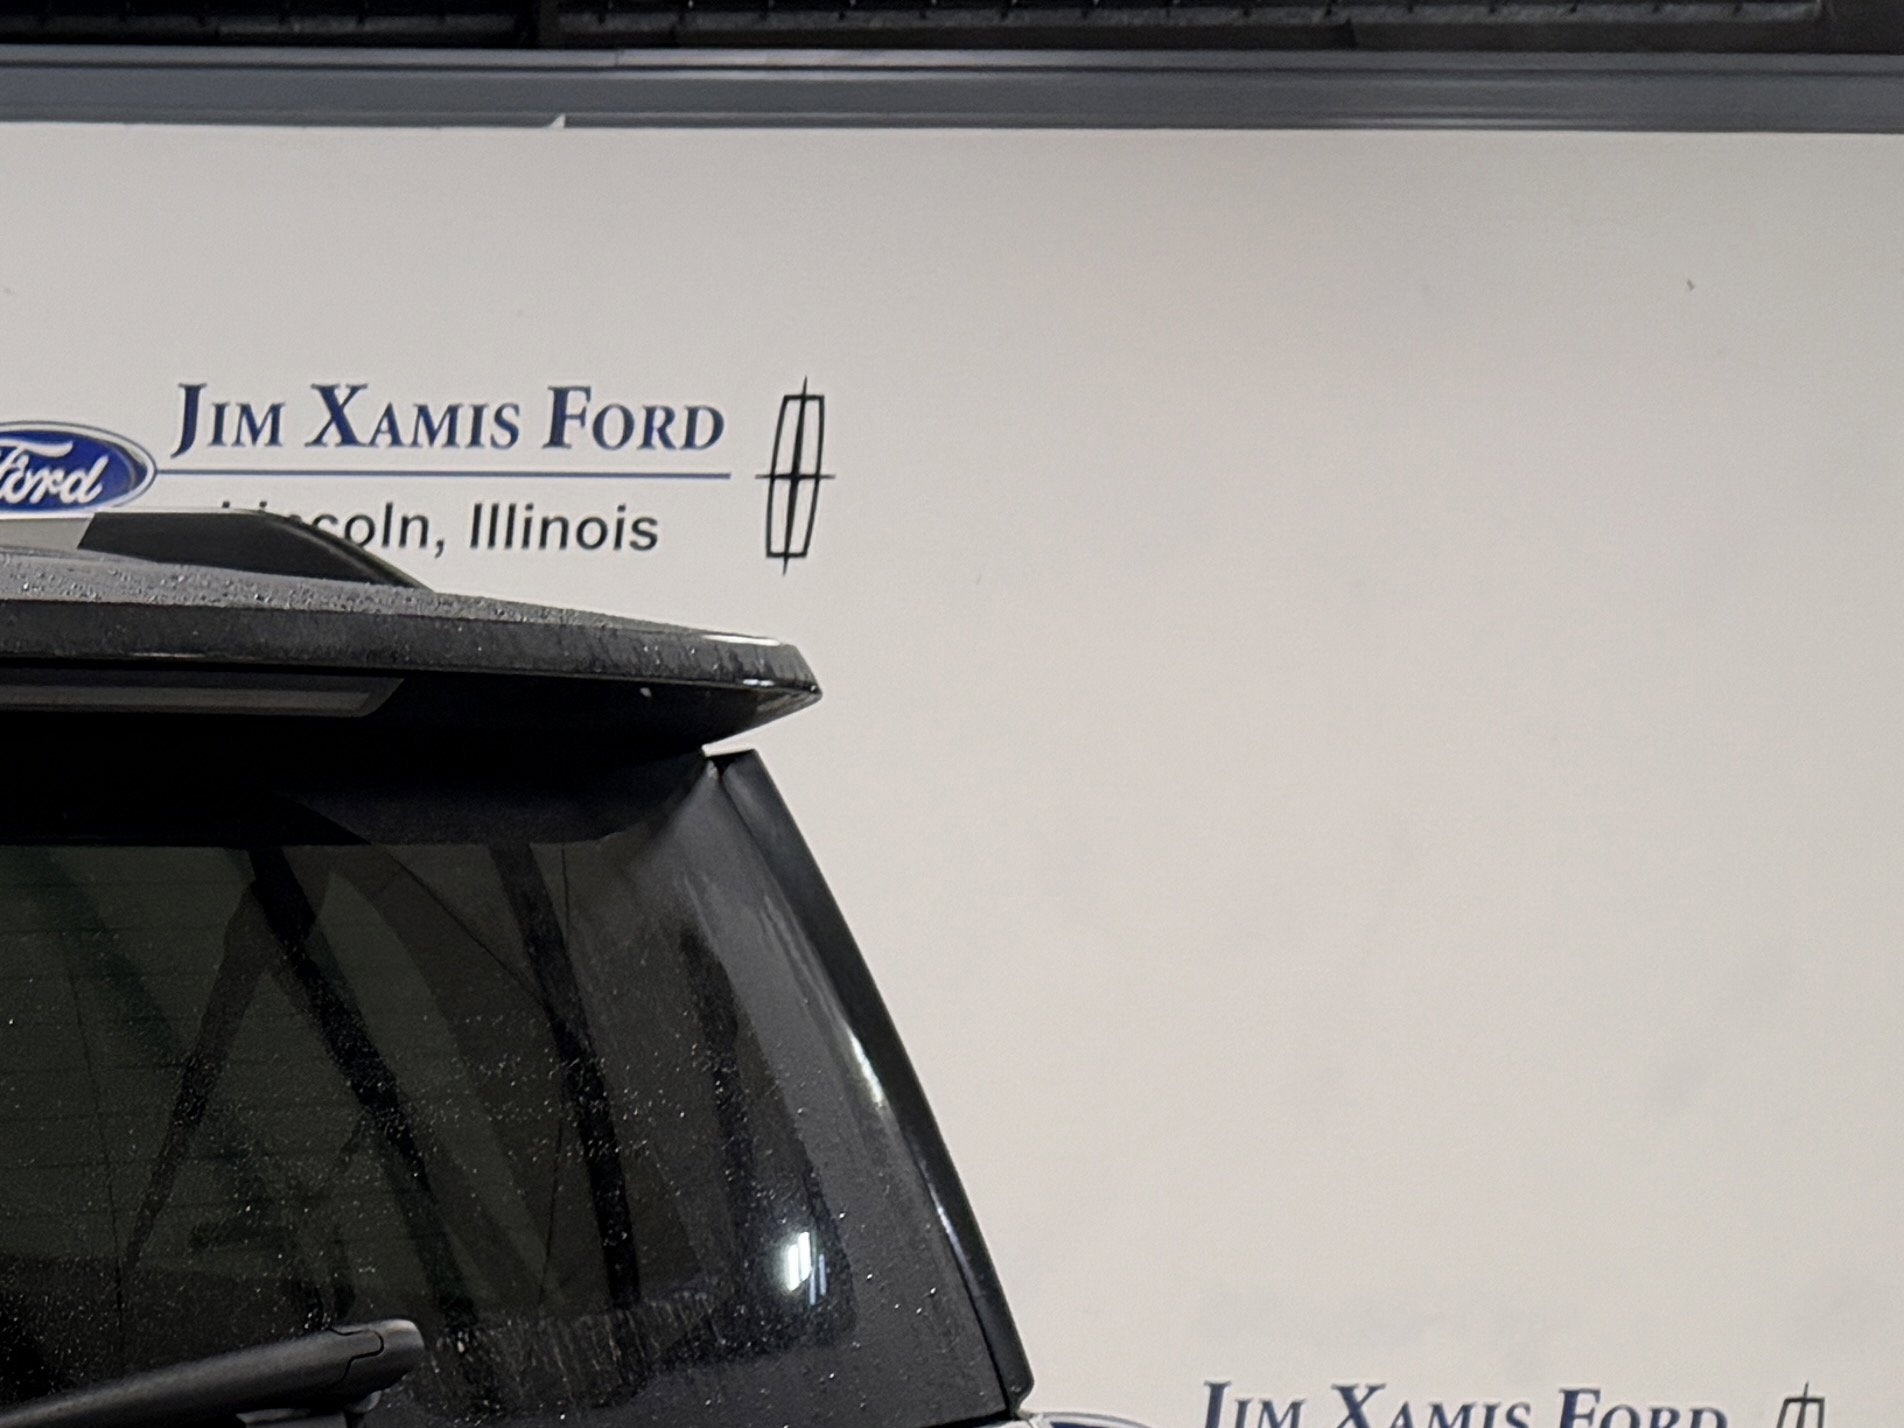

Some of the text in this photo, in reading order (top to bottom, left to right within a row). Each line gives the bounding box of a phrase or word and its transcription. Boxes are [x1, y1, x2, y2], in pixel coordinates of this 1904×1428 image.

[170, 383, 725, 459] JIM XAMIS FORD
[469, 502, 658, 552] Illinois
